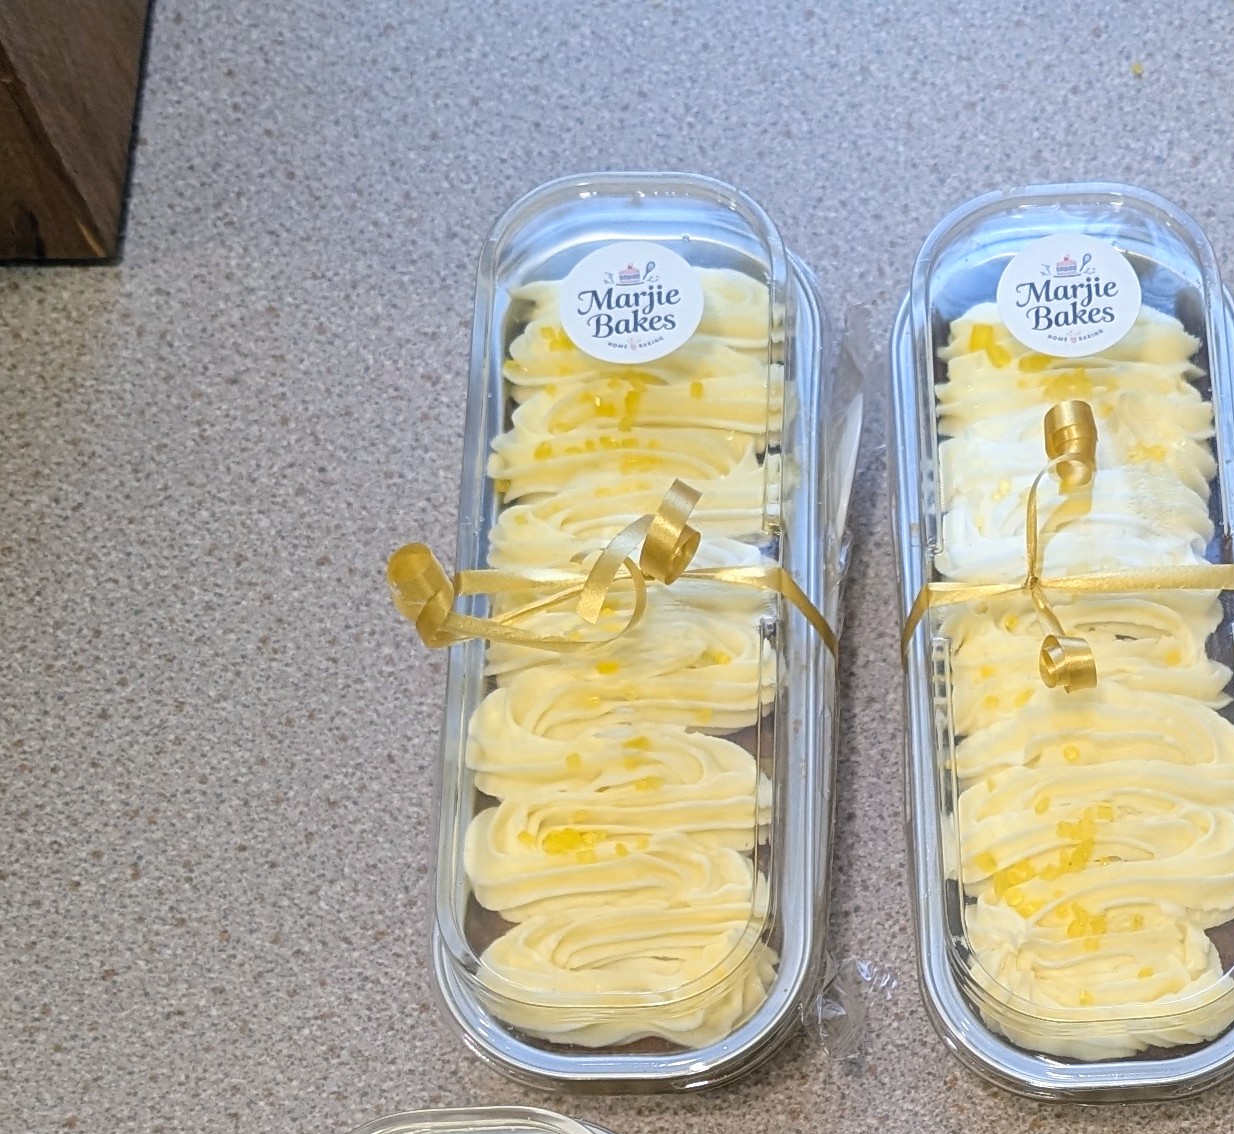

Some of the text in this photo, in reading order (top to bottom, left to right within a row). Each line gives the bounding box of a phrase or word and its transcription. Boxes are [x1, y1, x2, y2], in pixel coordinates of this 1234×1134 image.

[577, 285, 681, 315] Marjie
[1016, 277, 1118, 307] Marjie
[587, 309, 676, 338] Bakes
[1026, 302, 1115, 331] Bakes
